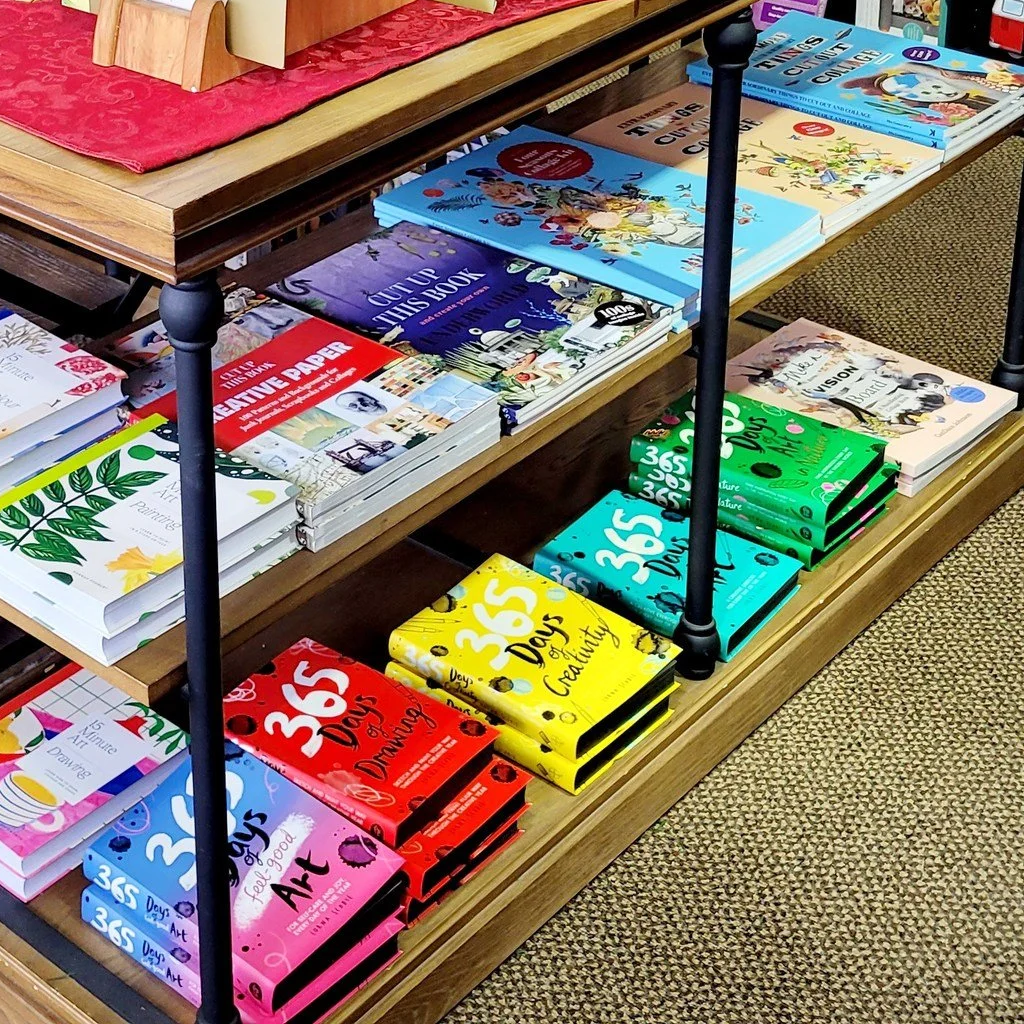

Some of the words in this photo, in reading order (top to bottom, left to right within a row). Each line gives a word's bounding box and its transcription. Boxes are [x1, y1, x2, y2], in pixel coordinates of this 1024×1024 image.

[753, 36, 824, 70] THINGS
[782, 56, 817, 77] CUT
[815, 42, 850, 61] OUT
[811, 49, 882, 85] COLLAGE
[624, 102, 705, 138] THINGS
[368, 279, 412, 309] CUT
[414, 267, 442, 292] UP
[371, 294, 431, 334] THIS
[432, 267, 487, 302] BOOK
[473, 285, 490, 296] own
[598, 304, 634, 318] 100s
[220, 365, 241, 380] CUT
[242, 361, 255, 370] UP
[220, 376, 248, 389] THIS
[249, 362, 276, 378] BOOK
[281, 341, 354, 381] PAPER
[816, 365, 859, 393] VISION
[846, 379, 888, 405] Board
[726, 416, 777, 453] Days
[767, 437, 803, 458] Art
[639, 446, 689, 475] 365
[639, 480, 682, 509] 365
[129, 500, 181, 531] Painting
[594, 509, 667, 586] 365
[455, 578, 538, 672] 365
[504, 614, 571, 669] Days
[543, 618, 620, 698] Creativity
[449, 668, 474, 689] Days
[263, 660, 350, 759] 365
[317, 694, 378, 748] Days
[77, 726, 119, 756] Minute
[354, 702, 438, 781] Drawing
[45, 746, 92, 781] Drawing
[244, 828, 297, 905] feel-good
[270, 850, 329, 913] Art
[93, 863, 141, 911] 365
[145, 895, 170, 921] Days
[169, 922, 189, 944] Art
[91, 907, 137, 954] 365
[141, 940, 166, 966] Days
[165, 970, 184, 989] Art
